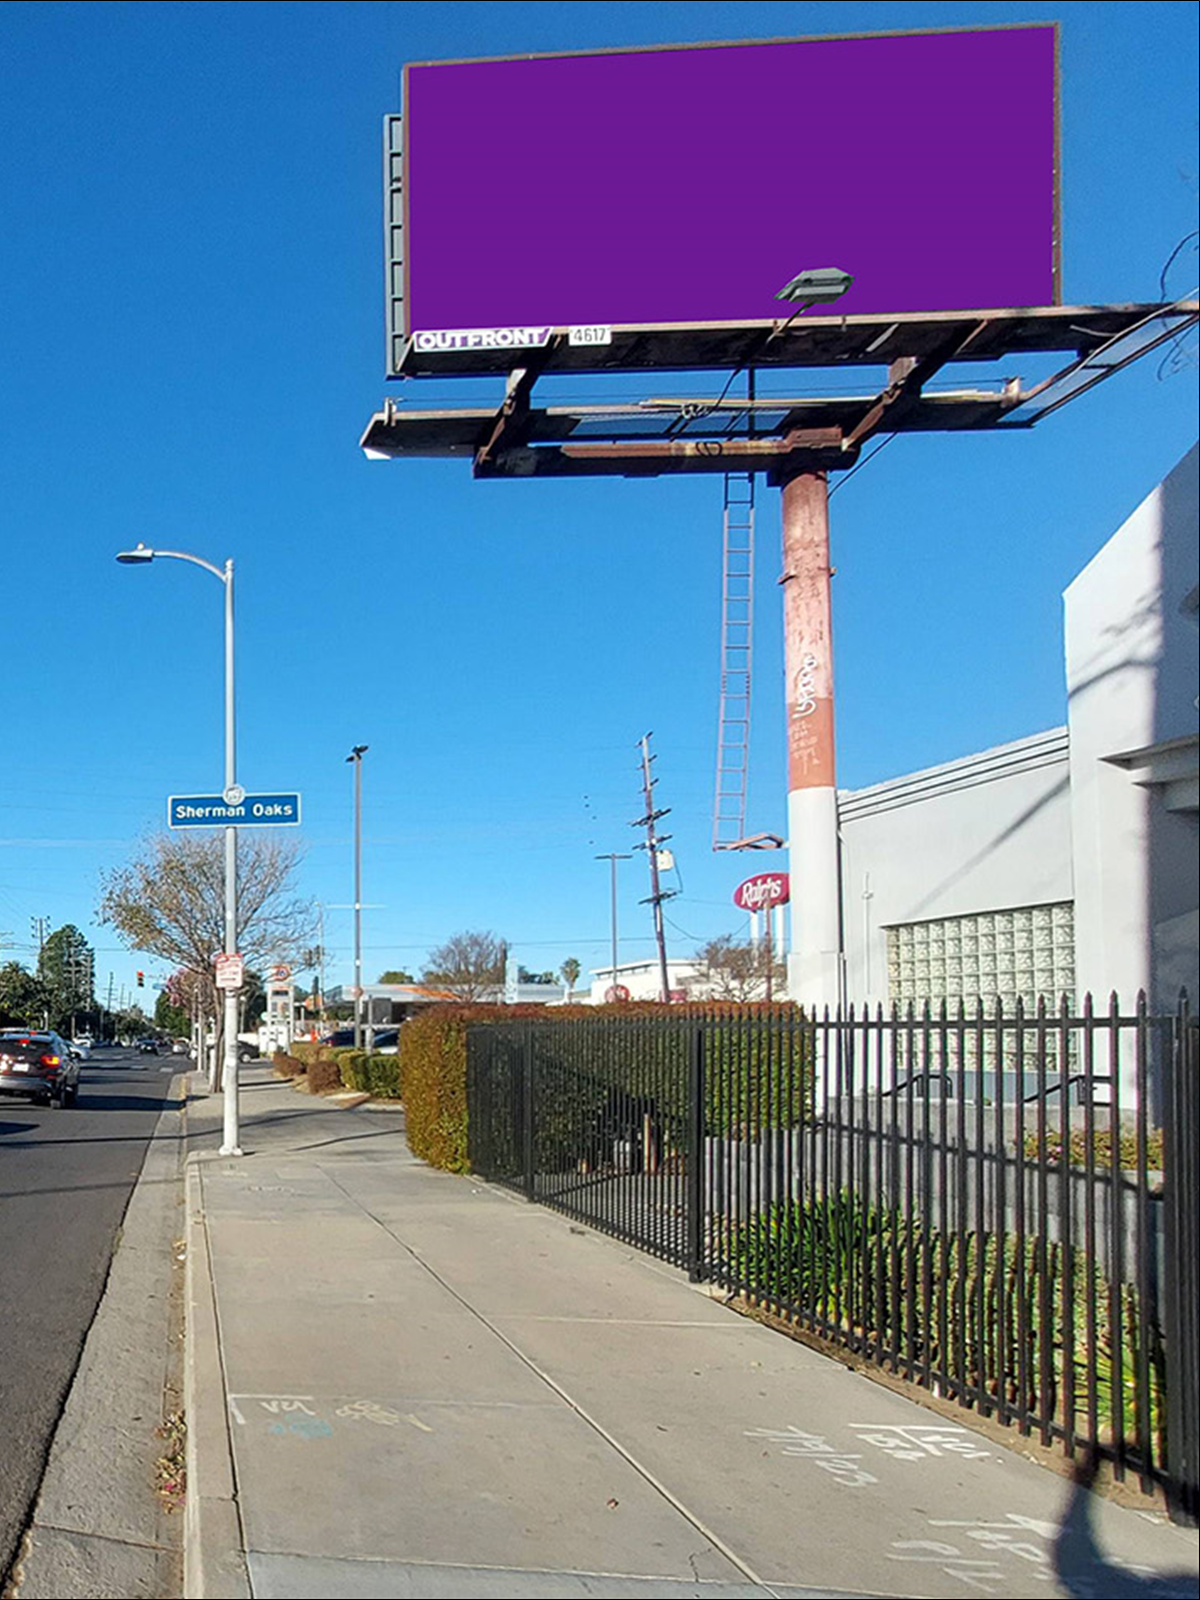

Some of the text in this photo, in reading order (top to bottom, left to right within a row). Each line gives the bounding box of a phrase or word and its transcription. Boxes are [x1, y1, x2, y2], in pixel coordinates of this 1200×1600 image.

[418, 328, 546, 349] OUTFRONT
[572, 327, 607, 342] 4617
[175, 803, 293, 819] Sherman Oaks
